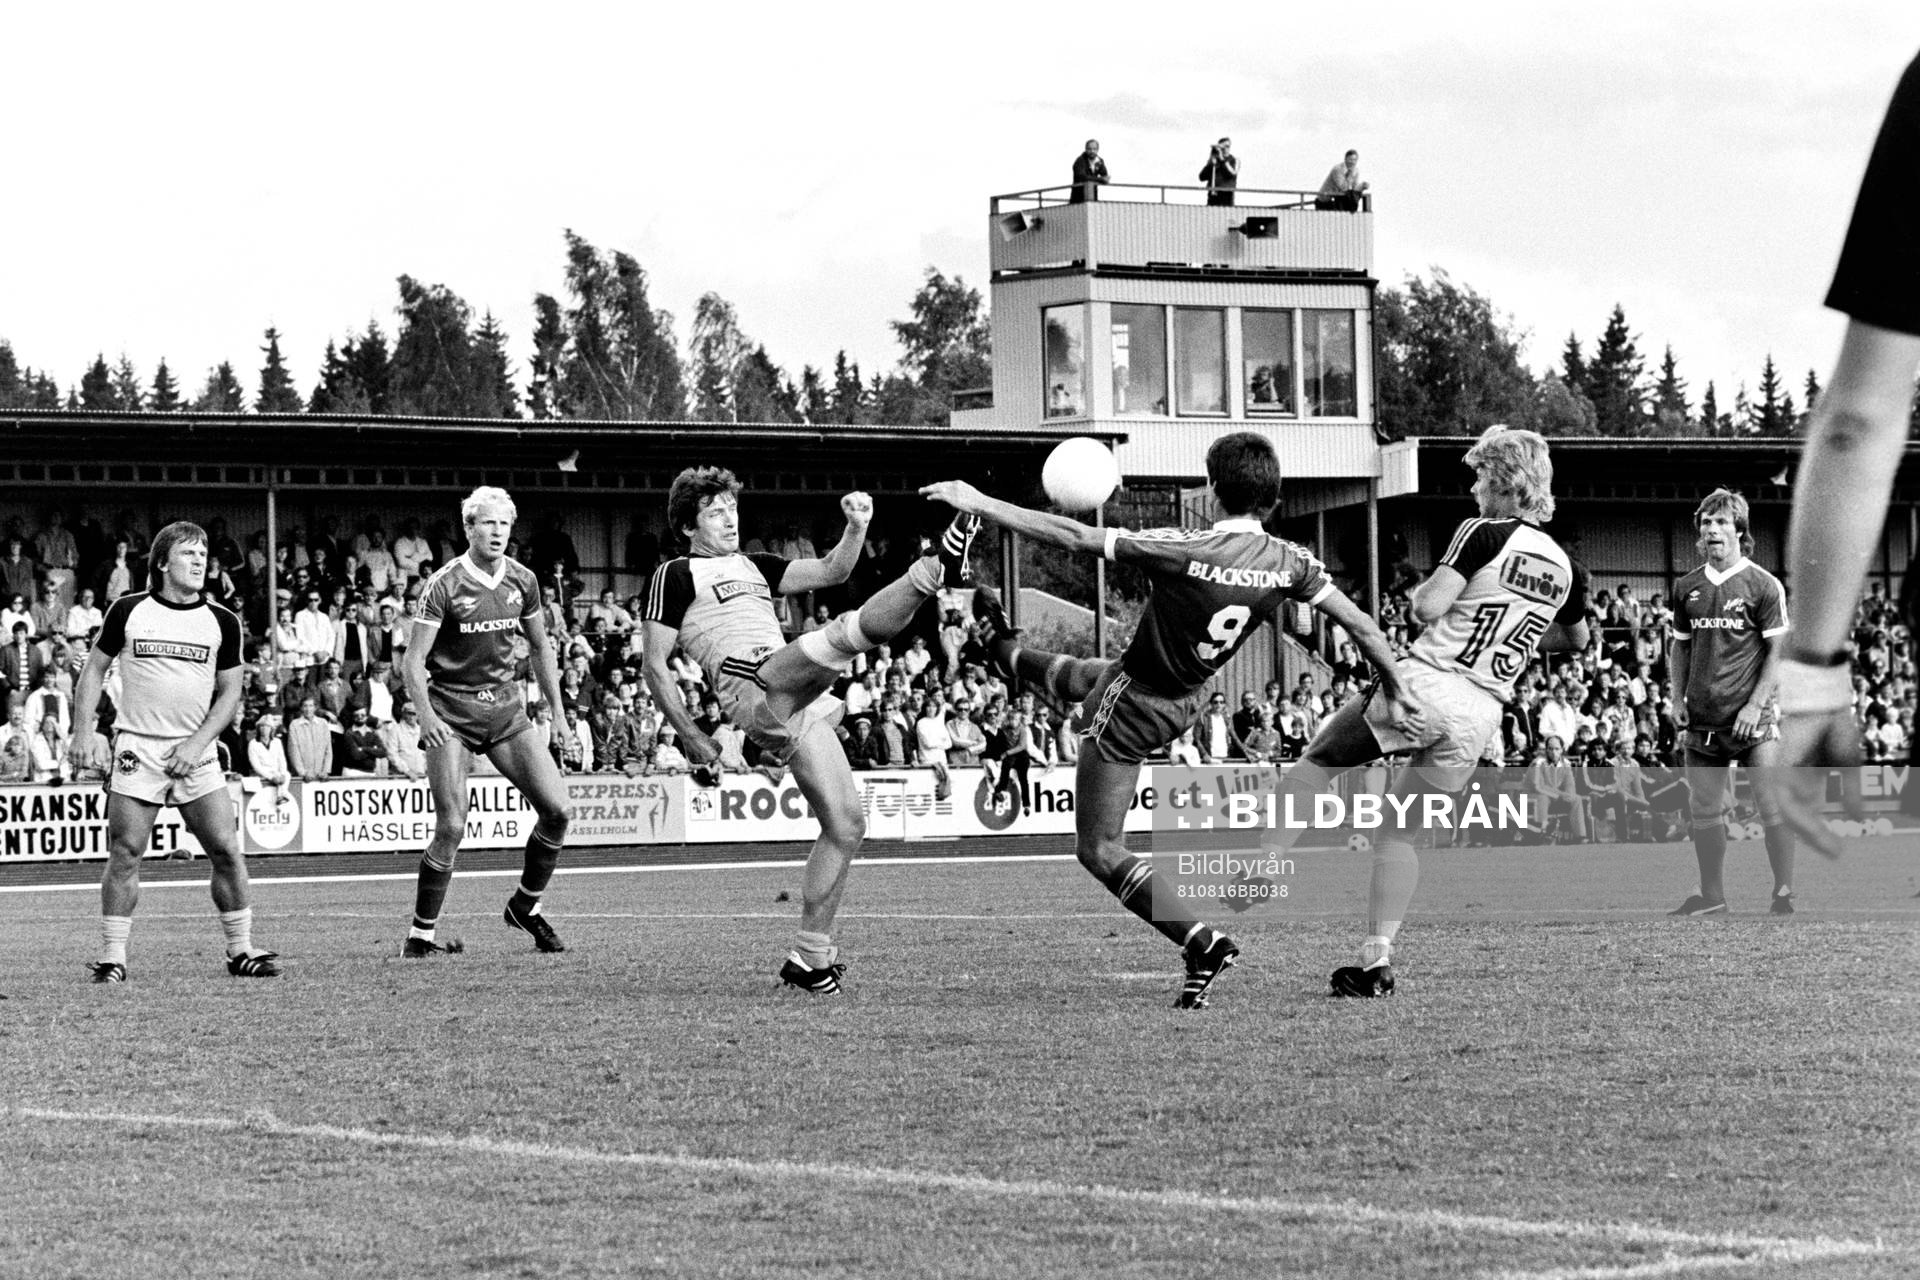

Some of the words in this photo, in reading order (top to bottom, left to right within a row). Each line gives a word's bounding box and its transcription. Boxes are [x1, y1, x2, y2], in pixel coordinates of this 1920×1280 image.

[1187, 560, 1293, 589] BLACKSTONE
[460, 616, 524, 633] BLACKSTON
[1197, 604, 1251, 660] 9
[137, 643, 205, 659] MODULENT
[1455, 603, 1550, 682] 15
[567, 783, 659, 799] EXPRESS
[0, 793, 109, 823] SKANSK
[342, 820, 483, 842] HÄSSLEHM
[492, 820, 519, 838] AB
